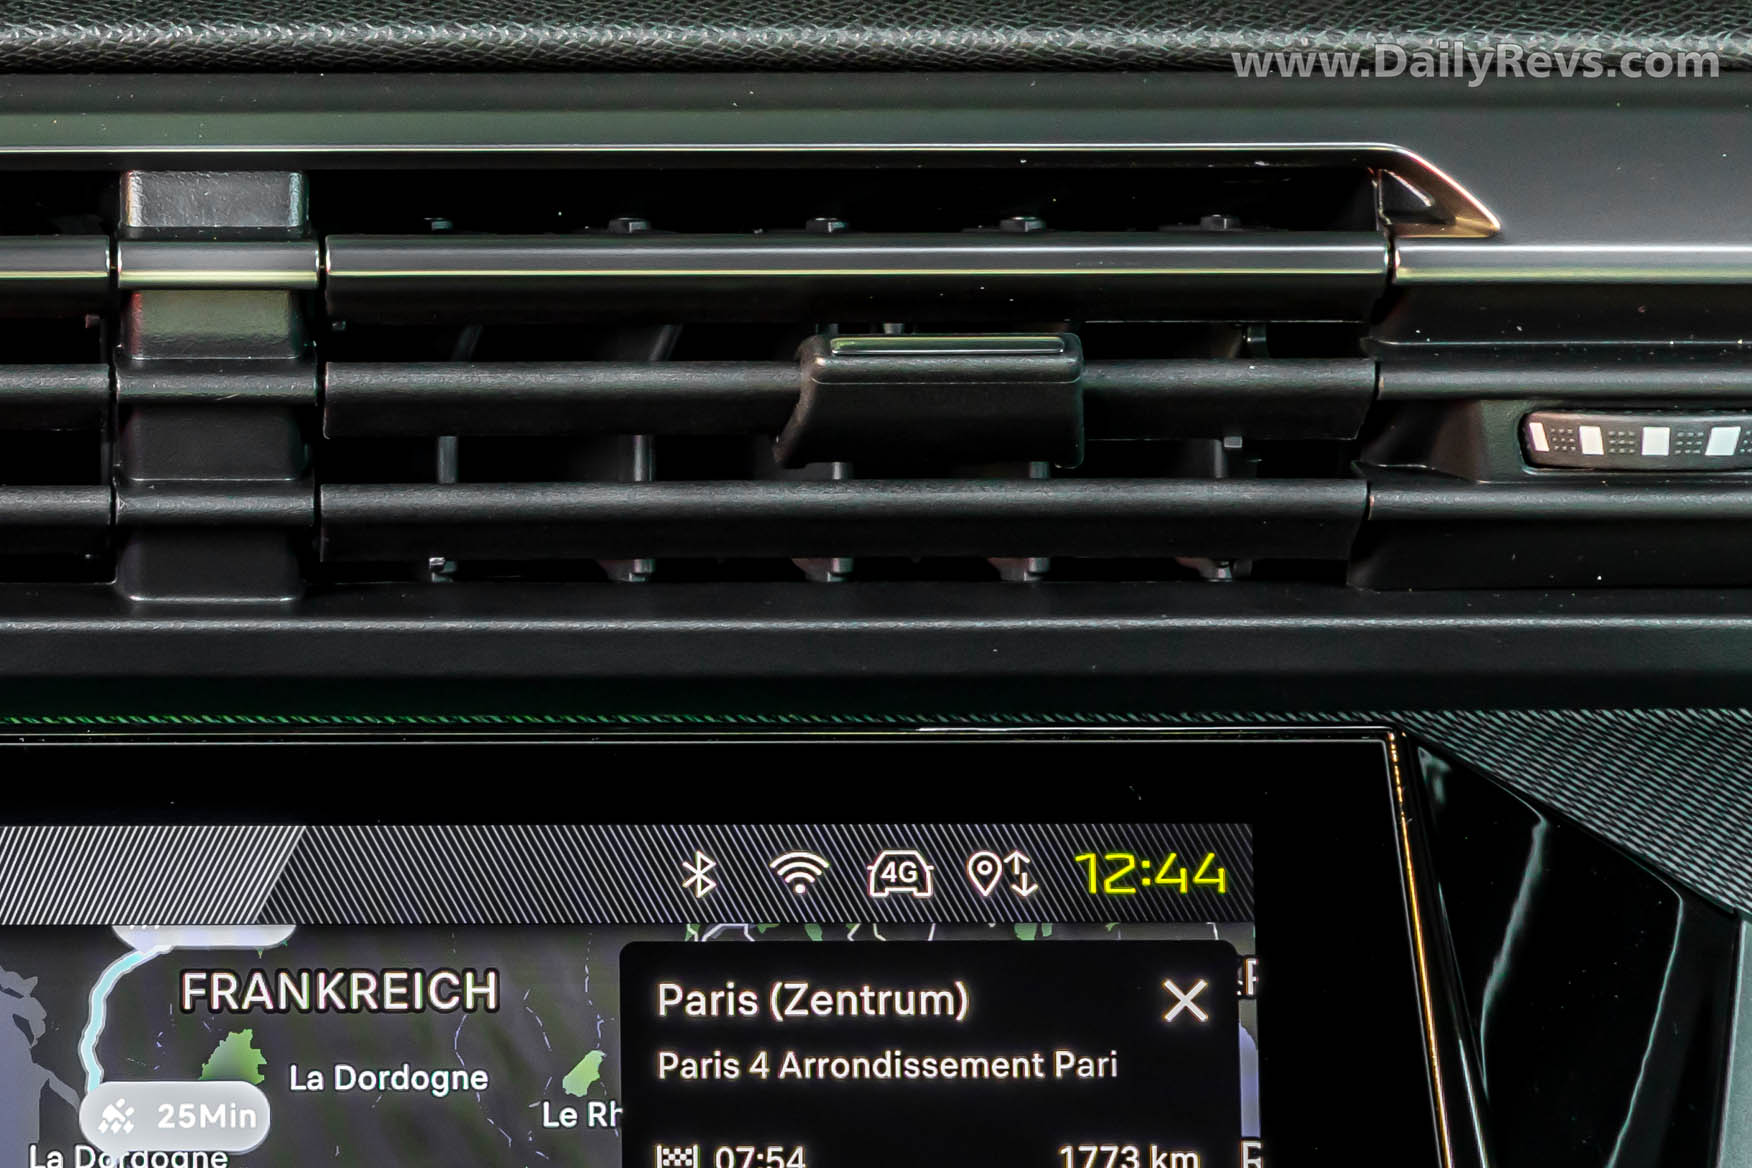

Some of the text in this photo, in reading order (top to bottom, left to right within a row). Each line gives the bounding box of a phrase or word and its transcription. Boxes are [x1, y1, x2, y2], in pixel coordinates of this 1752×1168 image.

[881, 862, 918, 883] 4G
[1075, 852, 1228, 894] 12:44
[182, 971, 498, 1011] FRANKREICH
[657, 980, 970, 1021] Paris (Zentrum)
[657, 1049, 1119, 1080] Paris 4 Arrondissement Pari
[290, 1065, 489, 1096] La Dordogne
[157, 1102, 258, 1129] 25Min
[543, 1101, 578, 1128] Le
